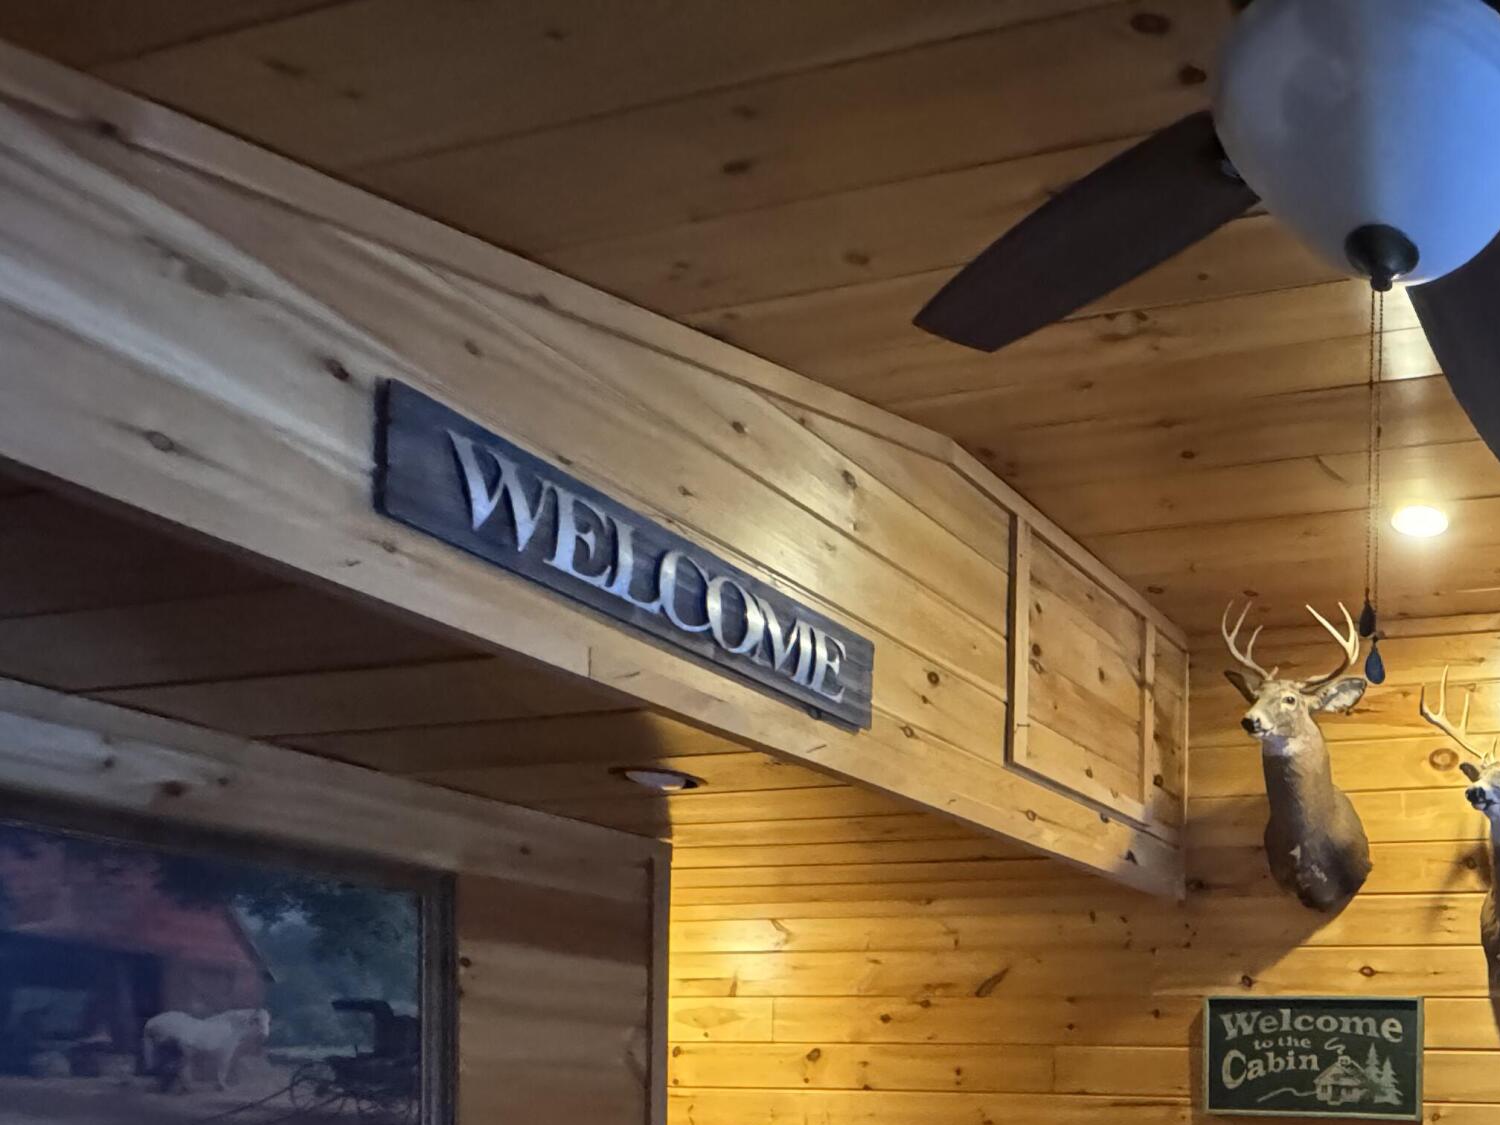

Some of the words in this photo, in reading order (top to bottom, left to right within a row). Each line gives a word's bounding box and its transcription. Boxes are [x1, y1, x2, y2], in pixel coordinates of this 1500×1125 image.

[446, 428, 847, 703] WELCOME
[1219, 1008, 1404, 1043] Welcome
[1253, 1039, 1274, 1050] to
[1278, 1036, 1312, 1049] the
[1222, 1049, 1321, 1090] Cabin
